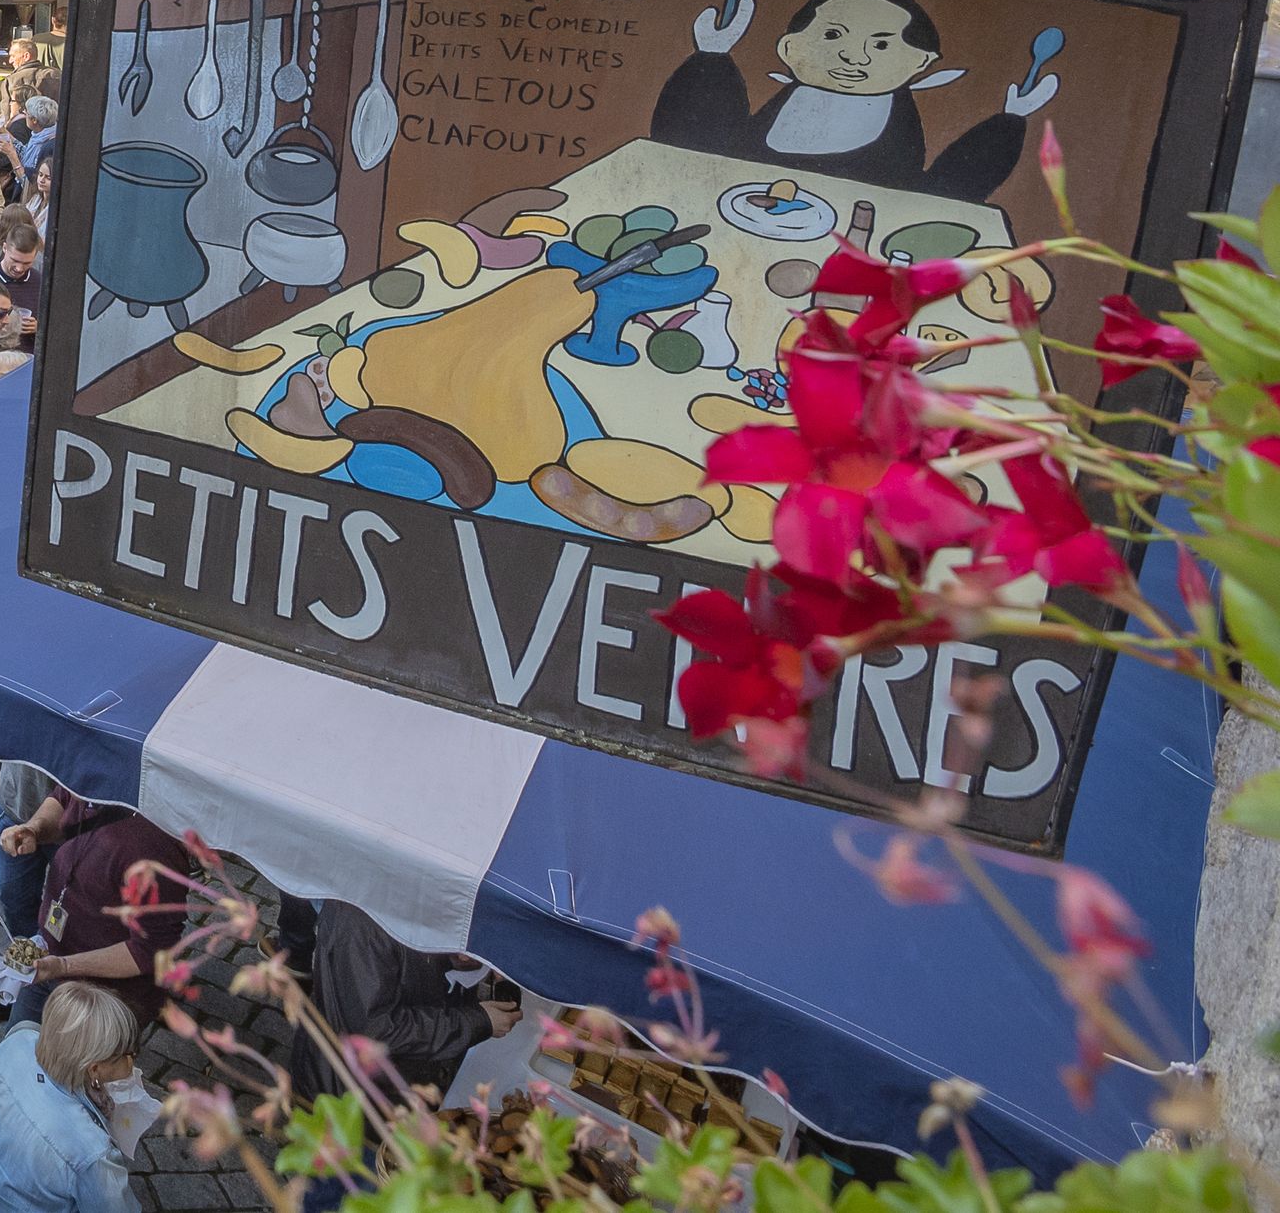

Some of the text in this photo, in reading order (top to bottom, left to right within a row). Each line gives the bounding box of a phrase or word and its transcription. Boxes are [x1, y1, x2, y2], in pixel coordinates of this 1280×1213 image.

[410, 1, 487, 29] JOUES
[408, 33, 625, 73] PETITS VENTRES
[402, 69, 598, 112] GALETOUS
[400, 114, 588, 158] CLAFOUTIS
[49, 429, 1082, 800] PETITS VERES
